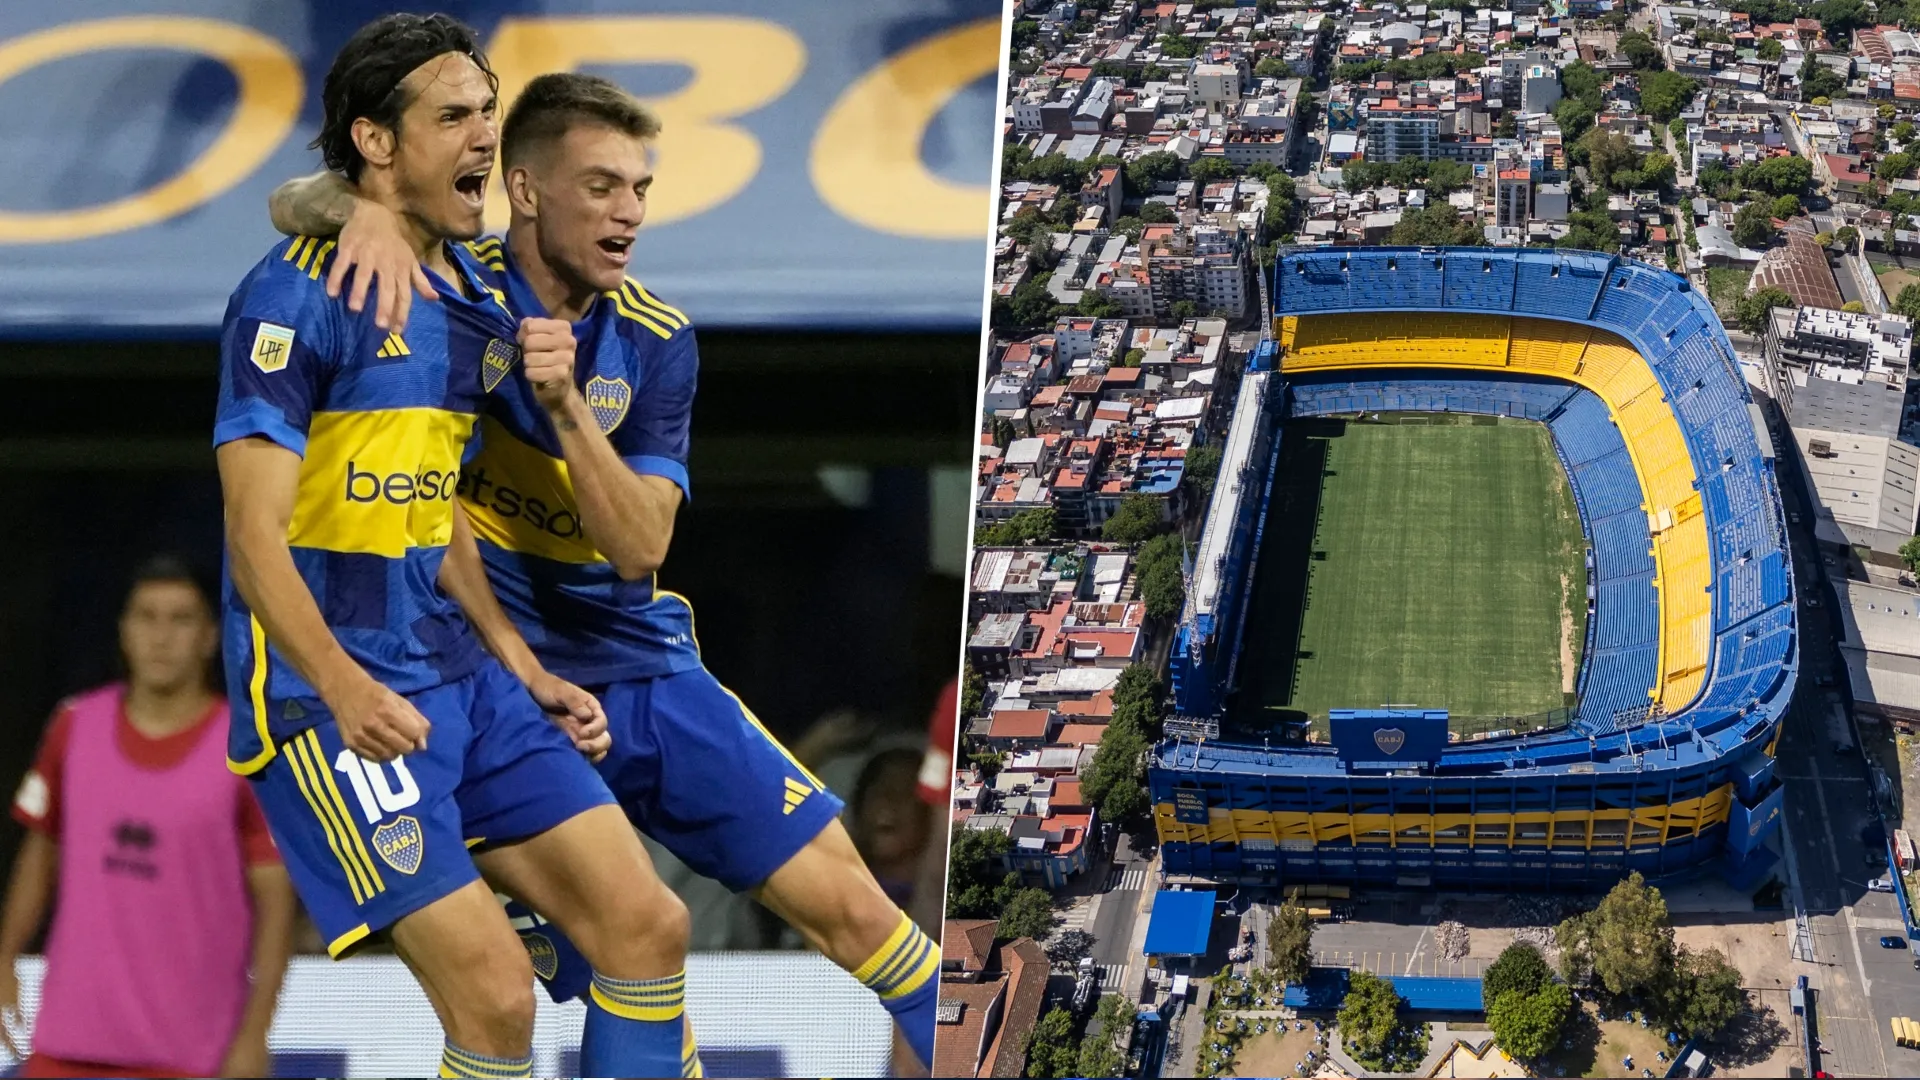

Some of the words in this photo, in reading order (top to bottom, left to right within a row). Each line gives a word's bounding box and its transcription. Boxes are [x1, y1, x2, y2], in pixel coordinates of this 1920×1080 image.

[485, 352, 510, 372] CABJ
[590, 395, 624, 410] CABJ
[334, 748, 421, 825] 10
[382, 831, 418, 856] CABJ
